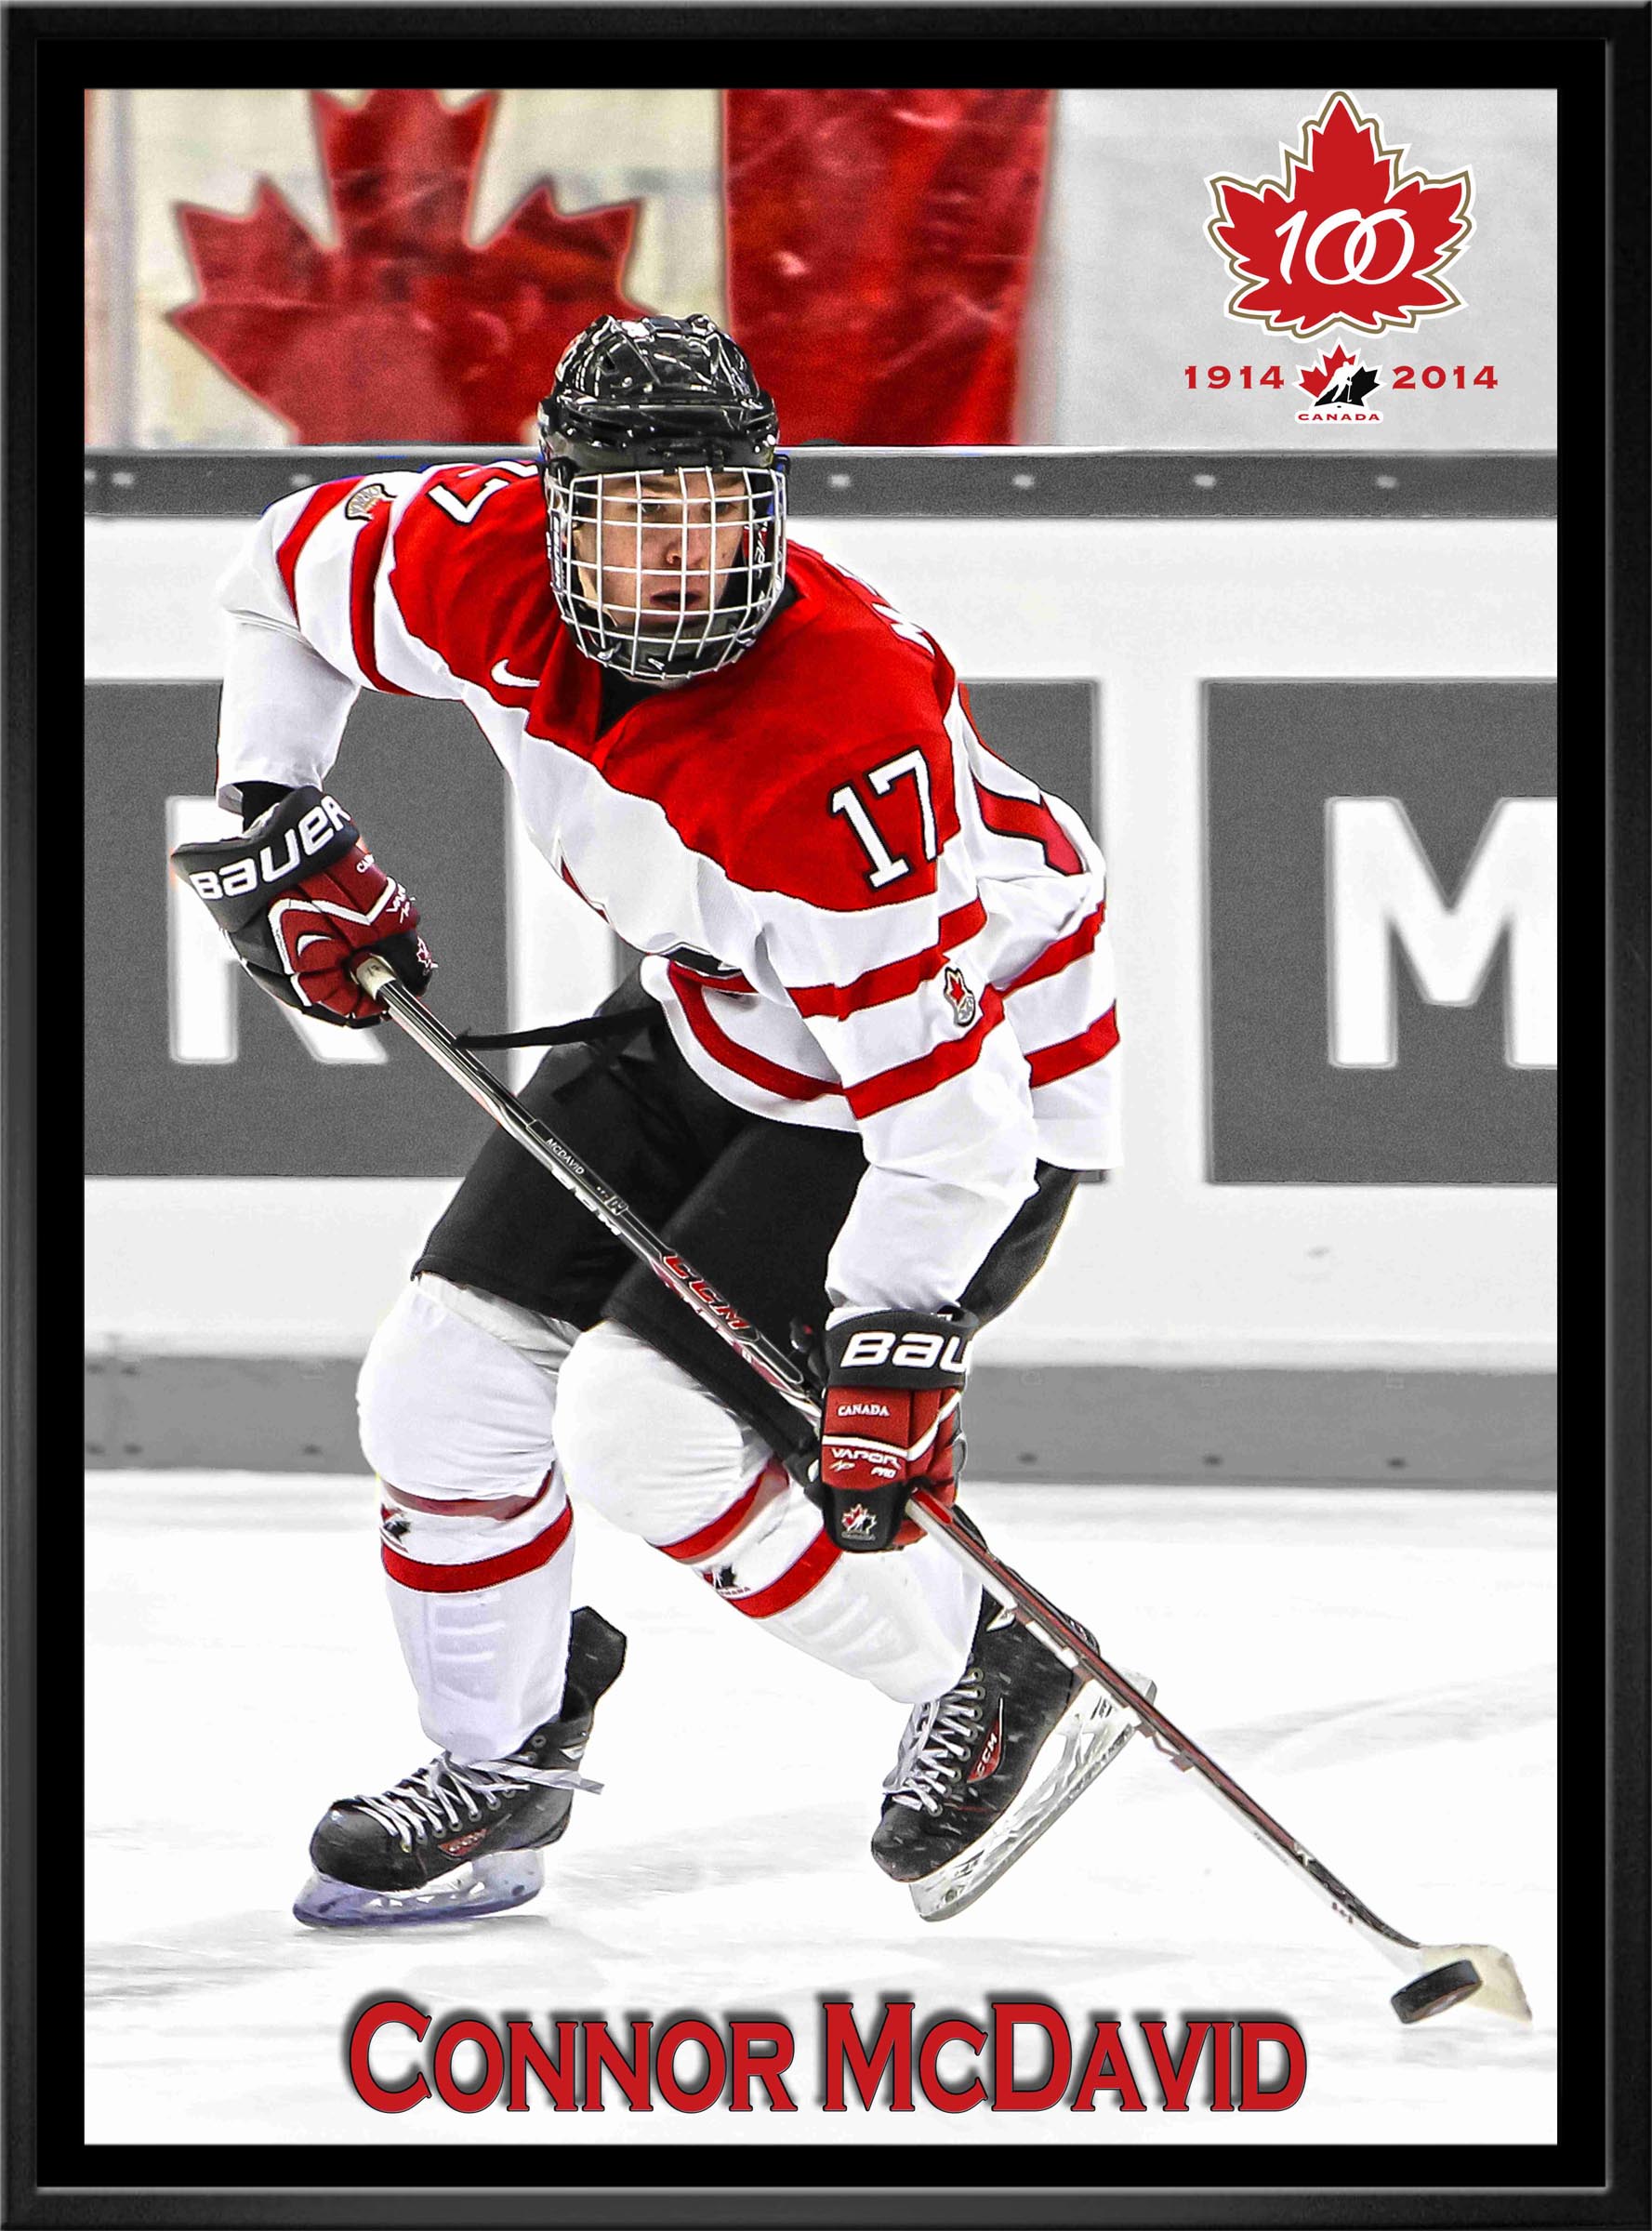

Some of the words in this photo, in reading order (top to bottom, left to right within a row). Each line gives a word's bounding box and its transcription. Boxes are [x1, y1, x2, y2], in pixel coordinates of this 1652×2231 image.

[830, 747, 936, 890] 17
[838, 1403, 890, 1418] CANADA
[831, 1447, 902, 1471] VAPOR
